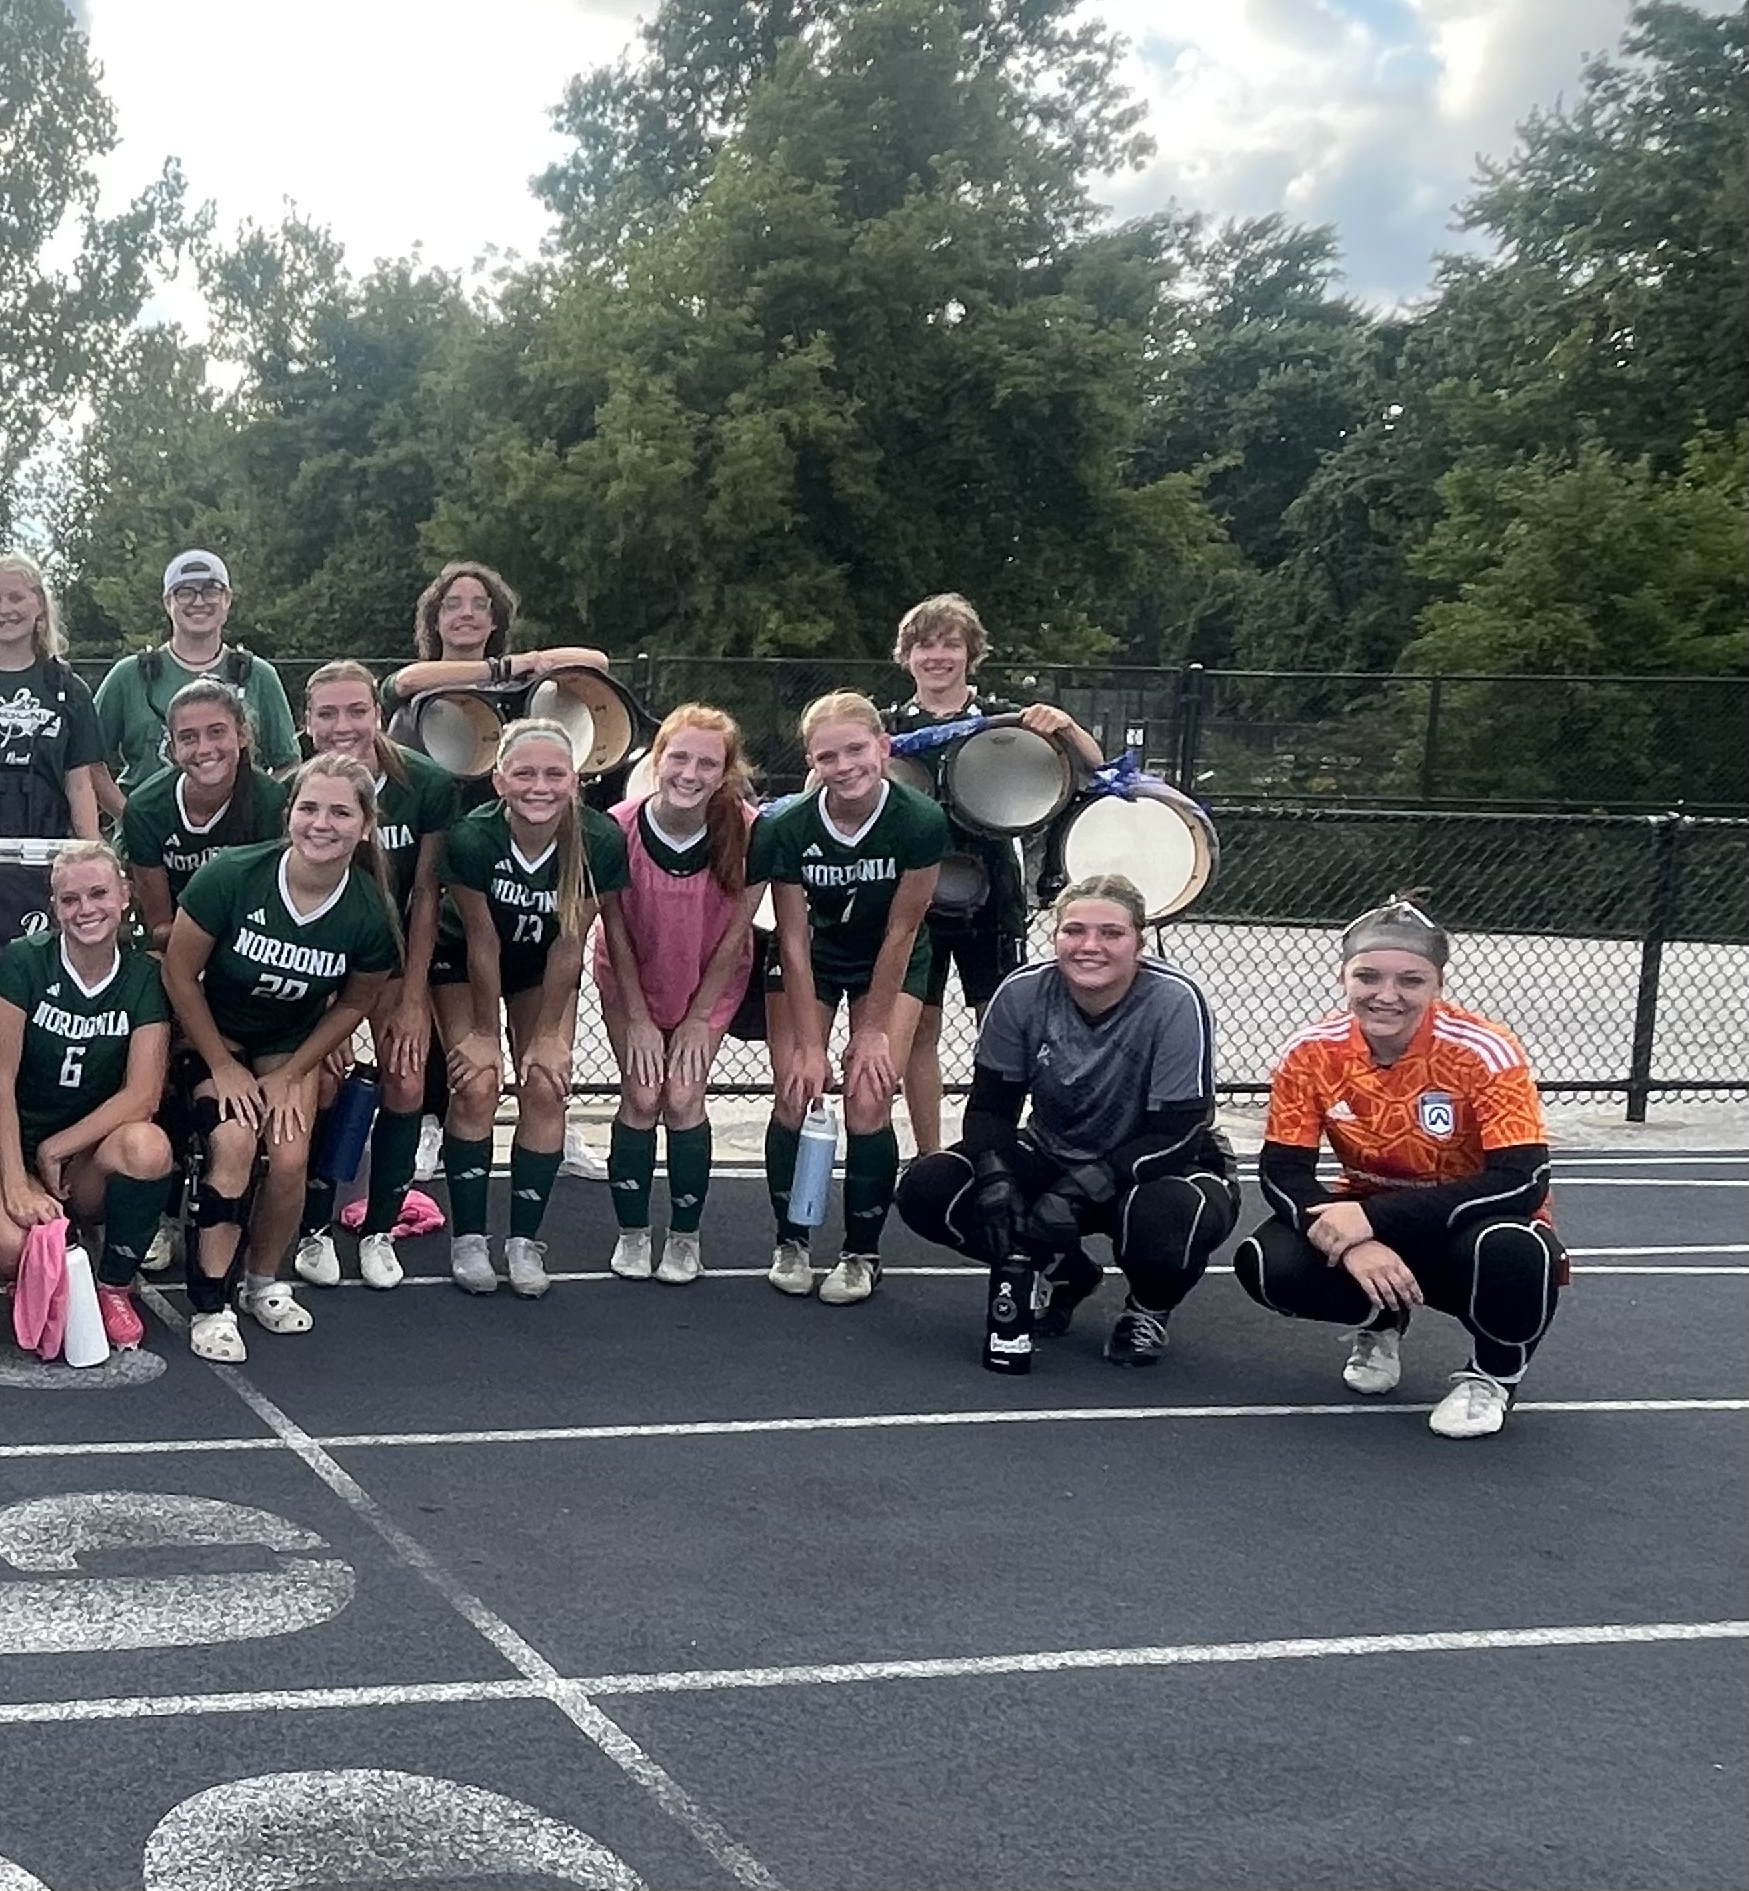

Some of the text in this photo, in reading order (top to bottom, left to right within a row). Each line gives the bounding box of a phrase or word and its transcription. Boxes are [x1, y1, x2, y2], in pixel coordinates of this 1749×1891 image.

[841, 888, 858, 924] 7
[233, 927, 347, 978] NORDONIA
[251, 973, 309, 1001] 20
[33, 1001, 130, 1040] NORDONIA
[59, 1046, 86, 1088] 6
